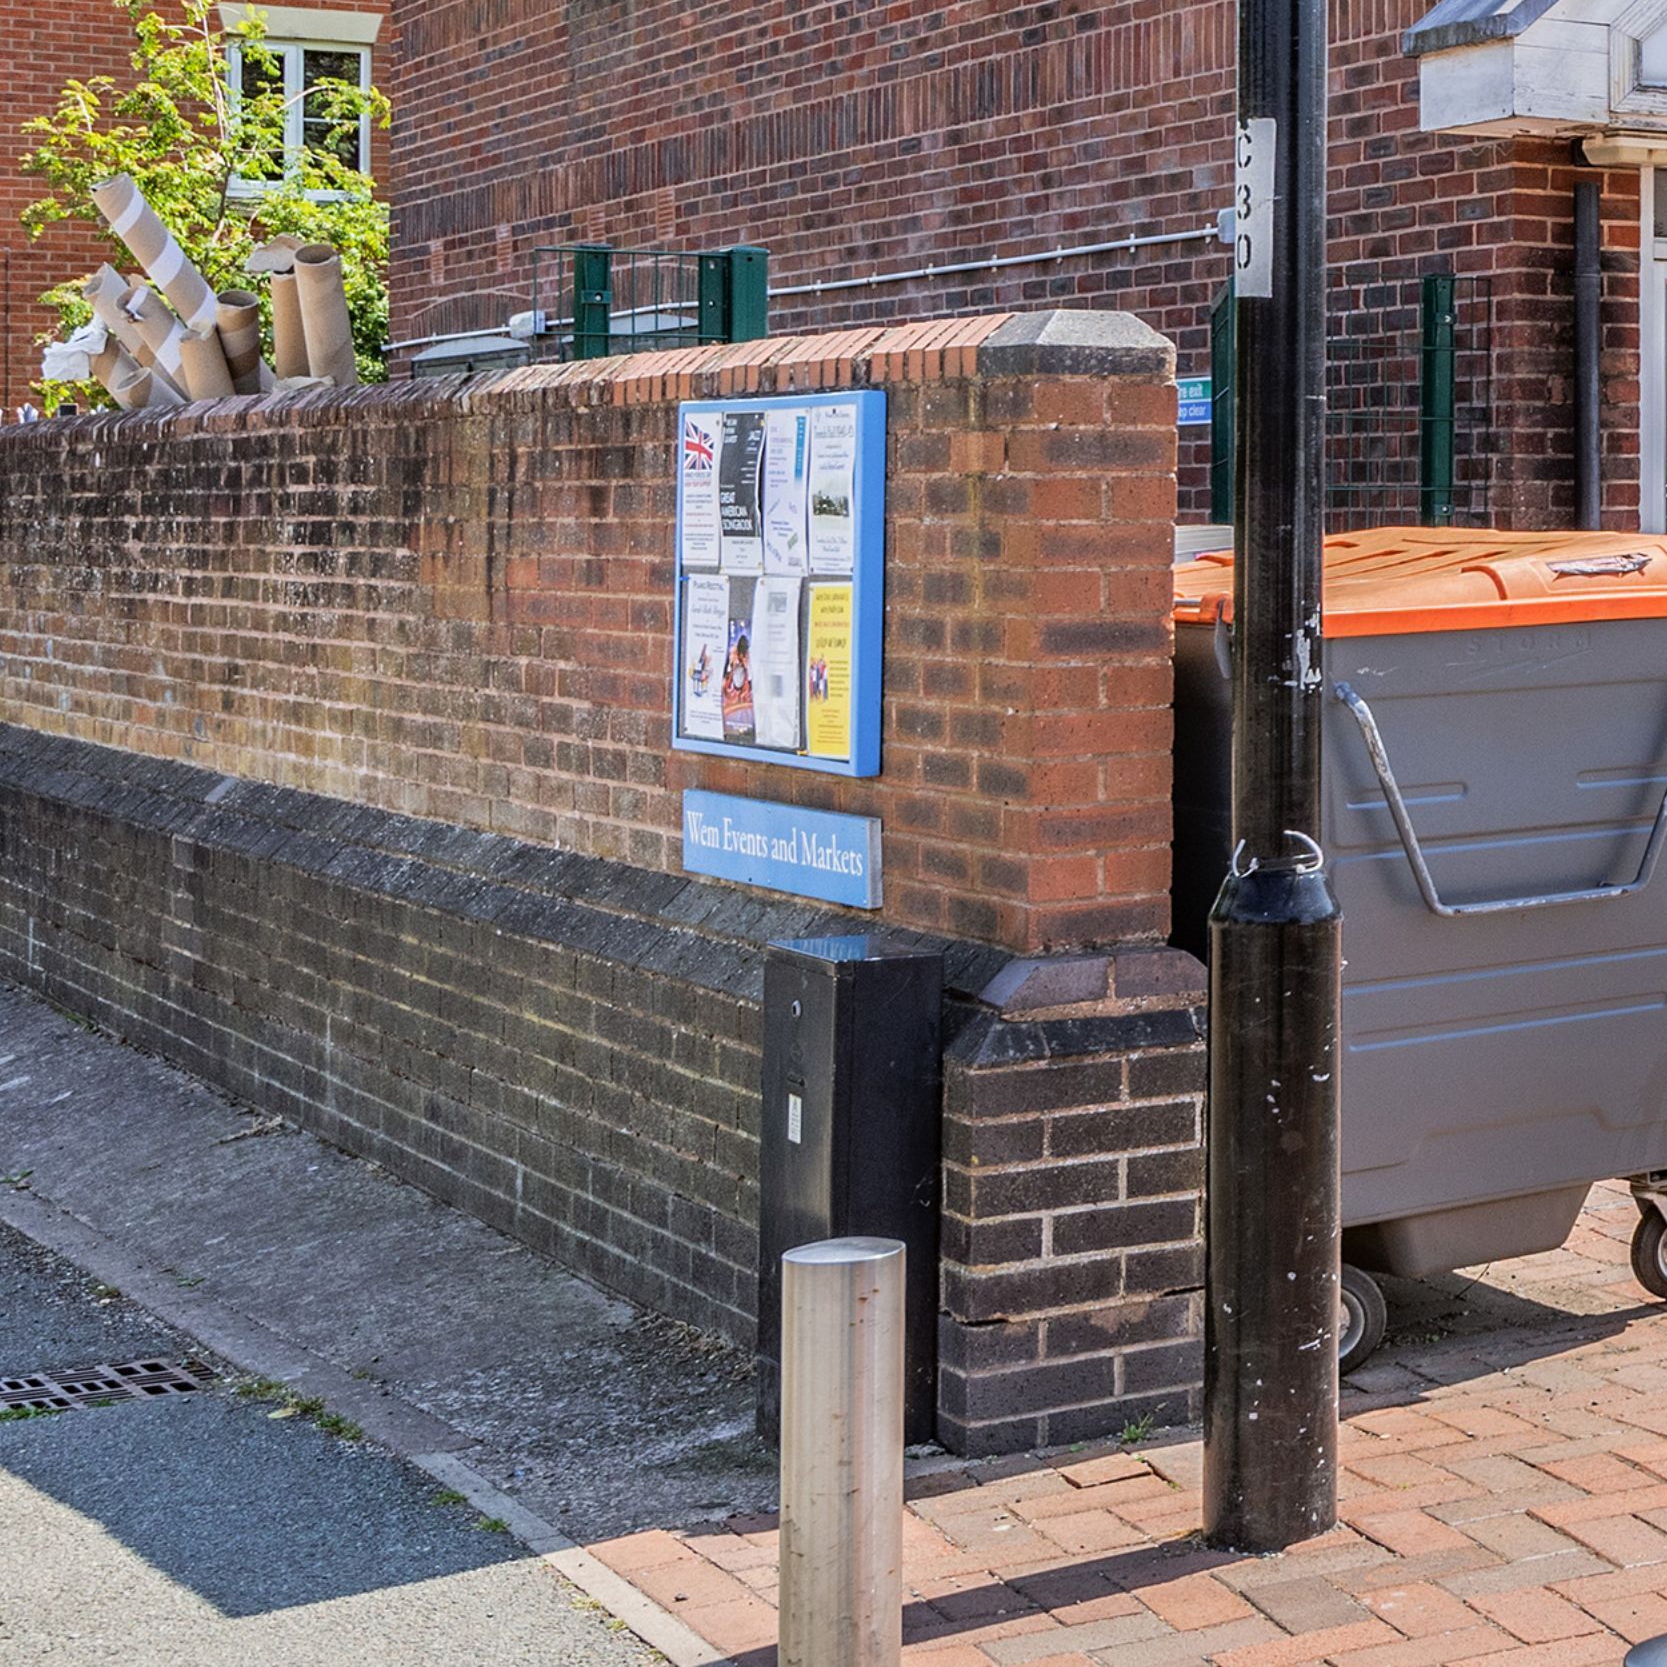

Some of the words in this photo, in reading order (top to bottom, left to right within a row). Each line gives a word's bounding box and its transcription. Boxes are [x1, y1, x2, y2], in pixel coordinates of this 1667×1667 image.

[686, 810, 720, 850] Wem
[723, 817, 769, 859] Events
[770, 827, 798, 864] and
[801, 831, 864, 877] Markets
